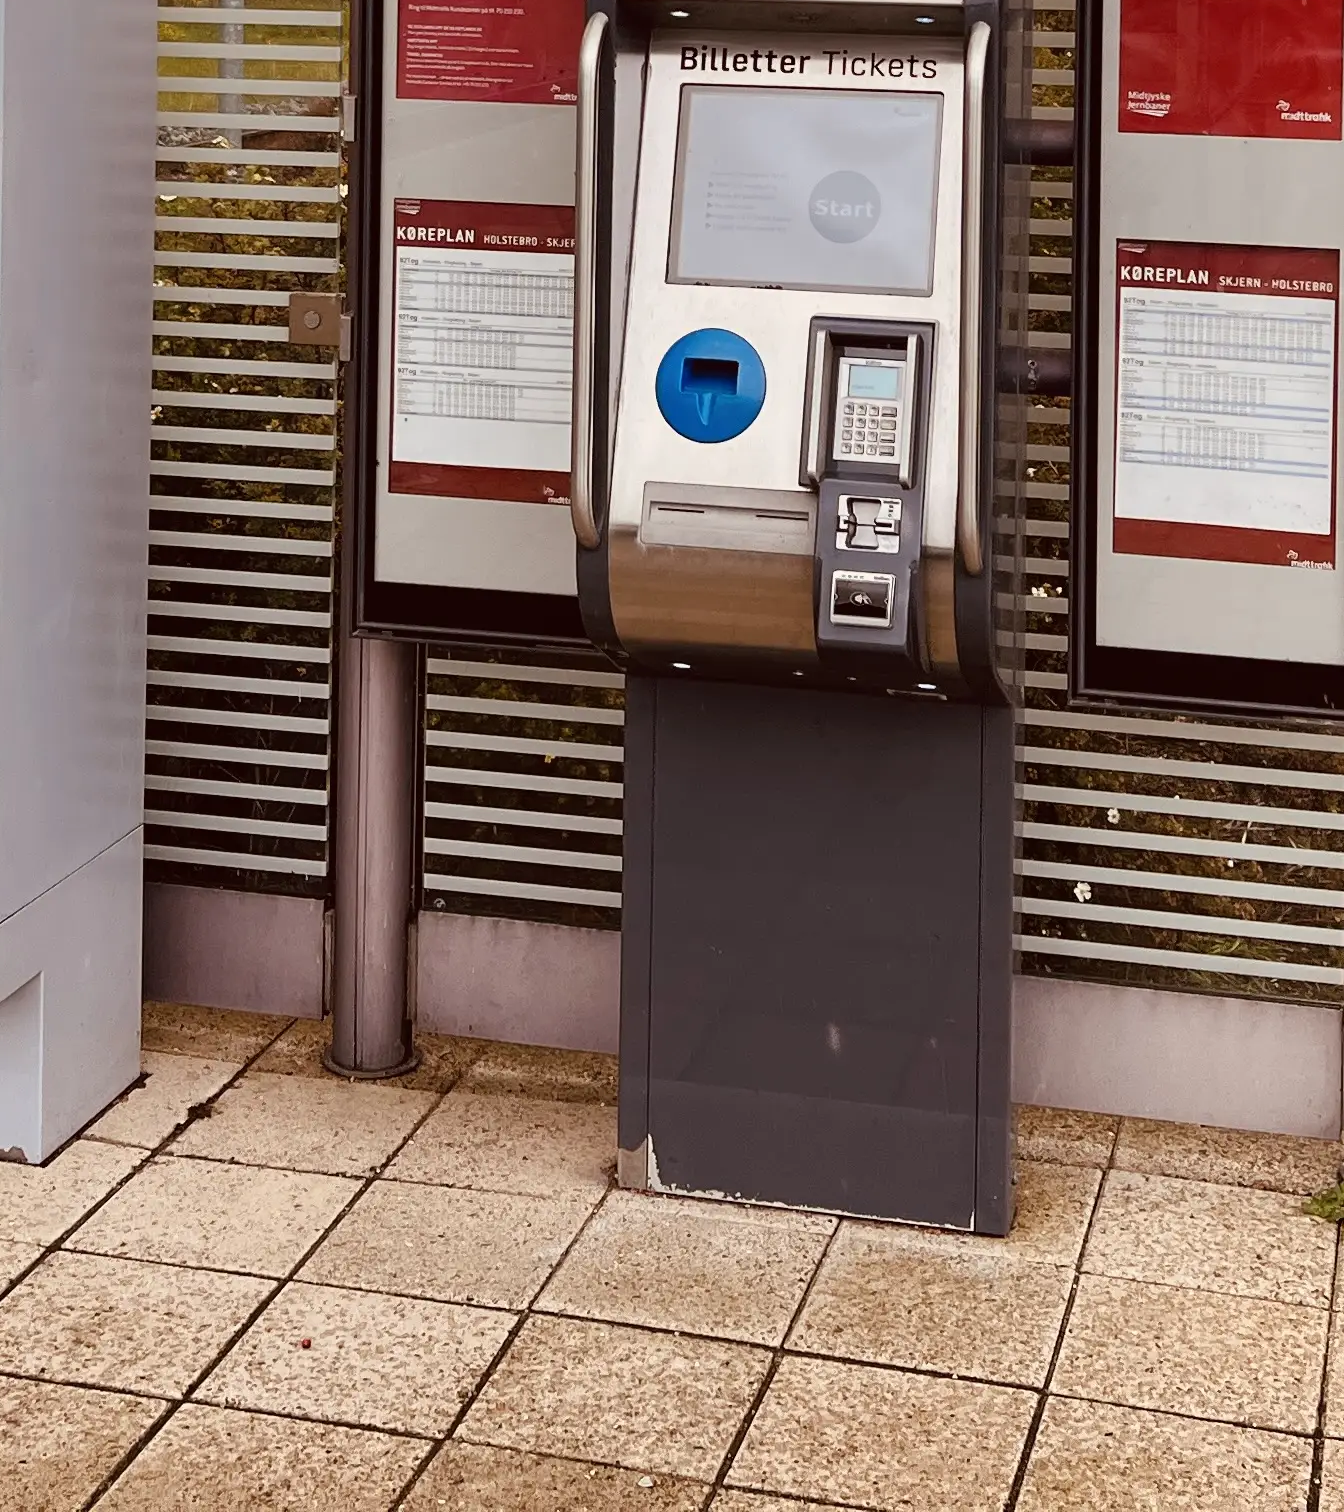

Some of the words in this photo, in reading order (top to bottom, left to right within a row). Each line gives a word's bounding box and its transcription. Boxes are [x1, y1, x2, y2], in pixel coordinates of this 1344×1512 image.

[679, 46, 810, 75] Billetter
[822, 50, 937, 79] Tickets
[1281, 112, 1332, 122] midttrafik
[814, 199, 875, 219] Start
[396, 226, 475, 243] KØREPLAN
[483, 235, 538, 247] HOLSTEBRO
[546, 237, 575, 248] SKJER
[1120, 265, 1209, 285] KØREPLAN
[1219, 275, 1261, 288] SKJERN
[1272, 279, 1334, 293] HOLSTEBRO
[1291, 560, 1333, 570] midttrafik
